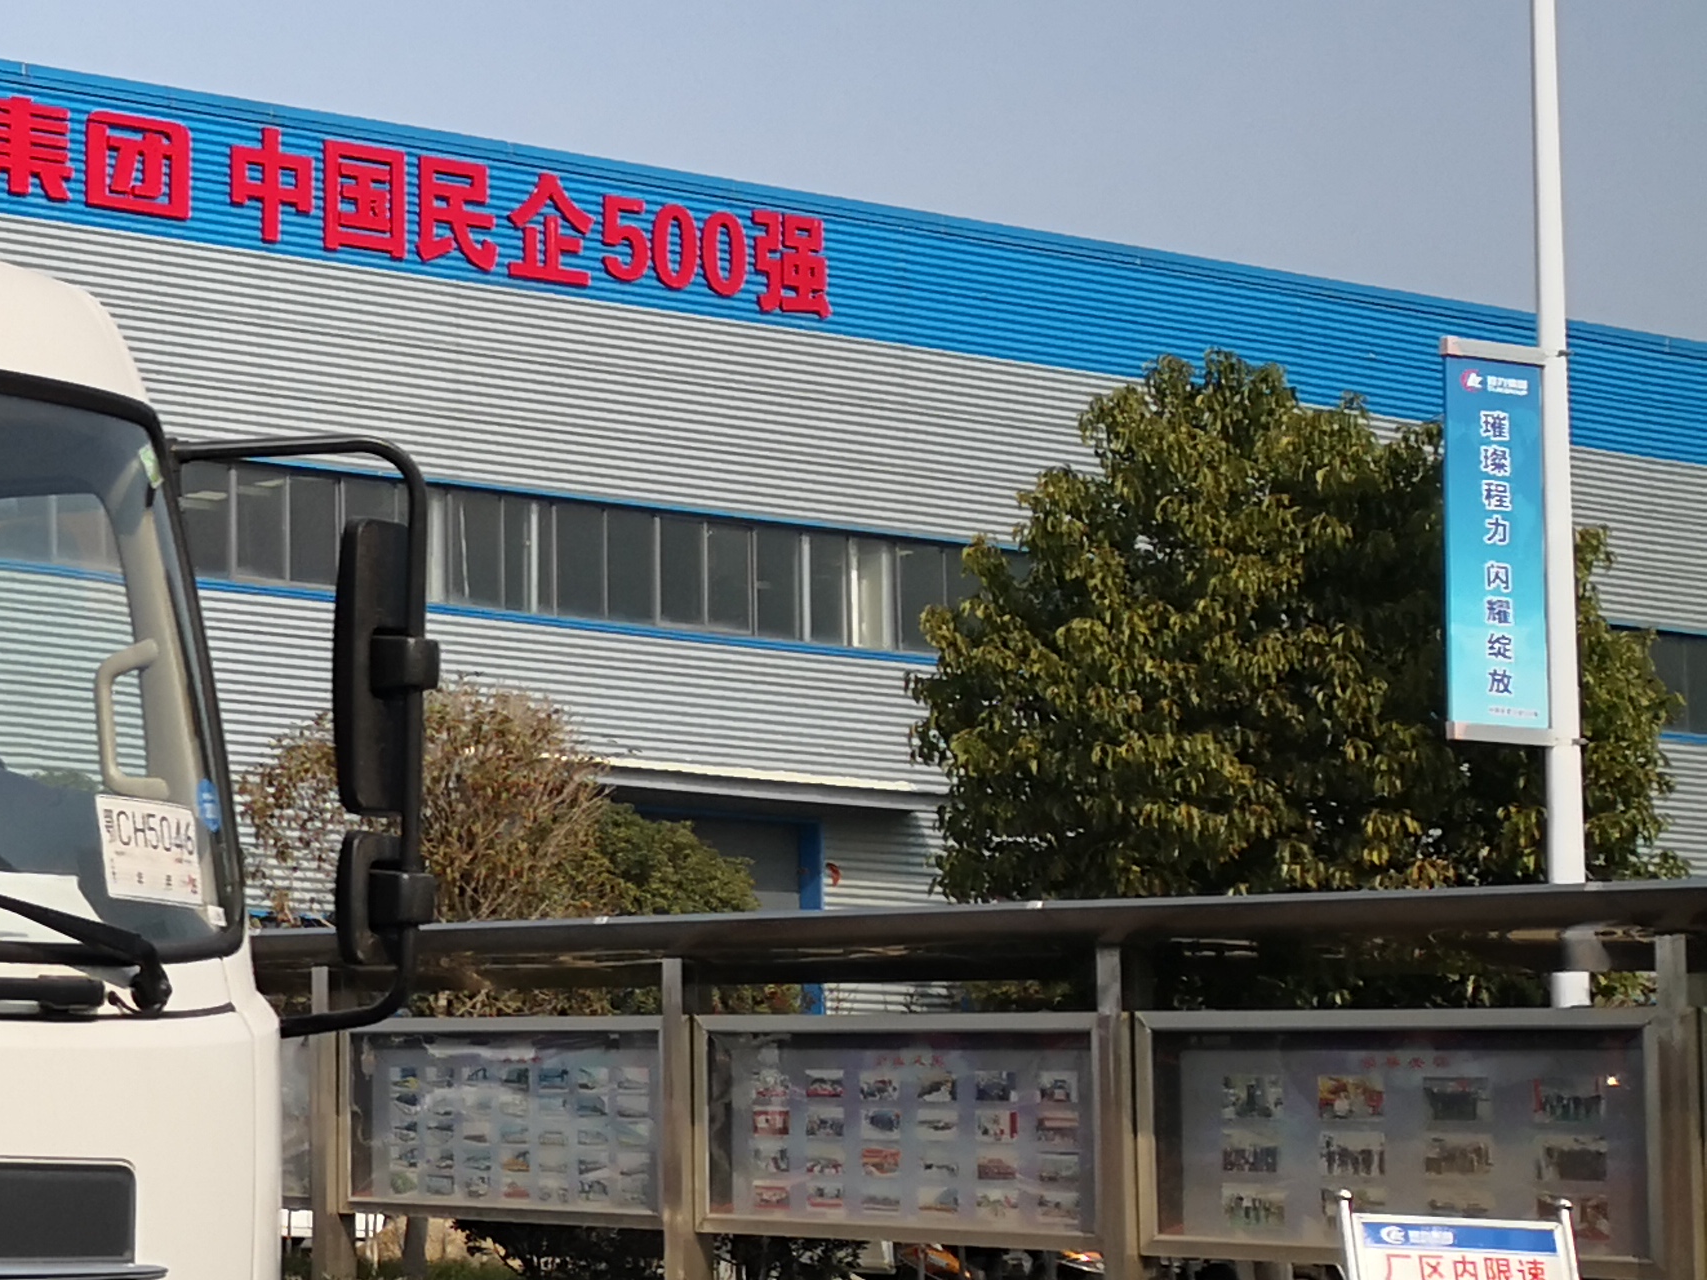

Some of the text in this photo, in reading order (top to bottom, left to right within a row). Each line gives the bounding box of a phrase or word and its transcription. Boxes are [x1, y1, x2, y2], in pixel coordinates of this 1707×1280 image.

[229, 126, 832, 319] 中国民企500强
[1485, 562, 1514, 696] 闪耀绽放
